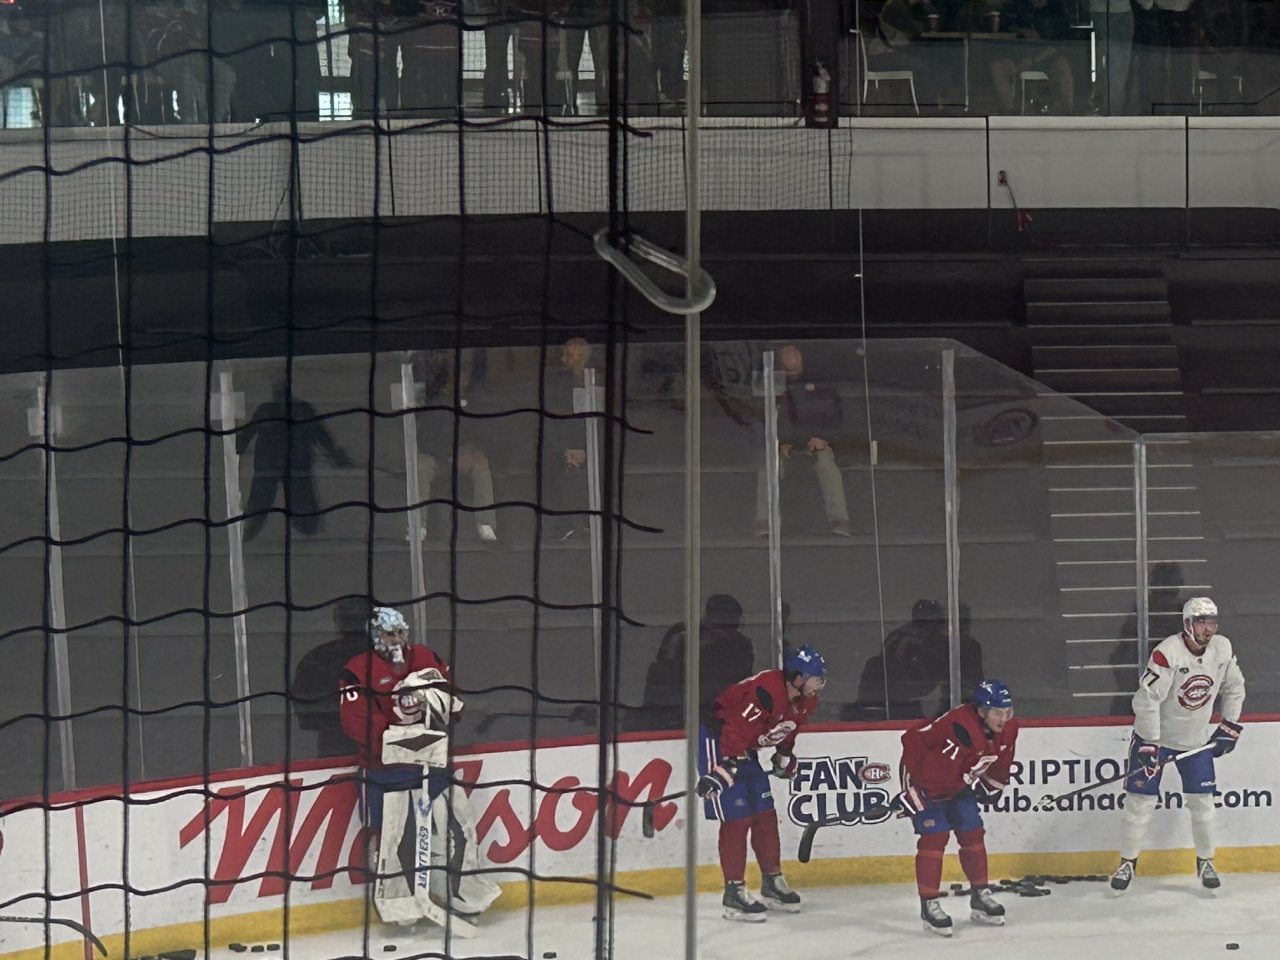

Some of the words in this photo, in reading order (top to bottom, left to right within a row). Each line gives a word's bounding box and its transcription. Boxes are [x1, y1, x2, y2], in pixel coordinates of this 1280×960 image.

[1142, 668, 1160, 687] 77
[742, 703, 762, 722] 17
[942, 738, 960, 760] 71
[793, 759, 864, 791] FAN
[1007, 758, 1130, 785] RIPTIO
[790, 790, 891, 825] CLUB
